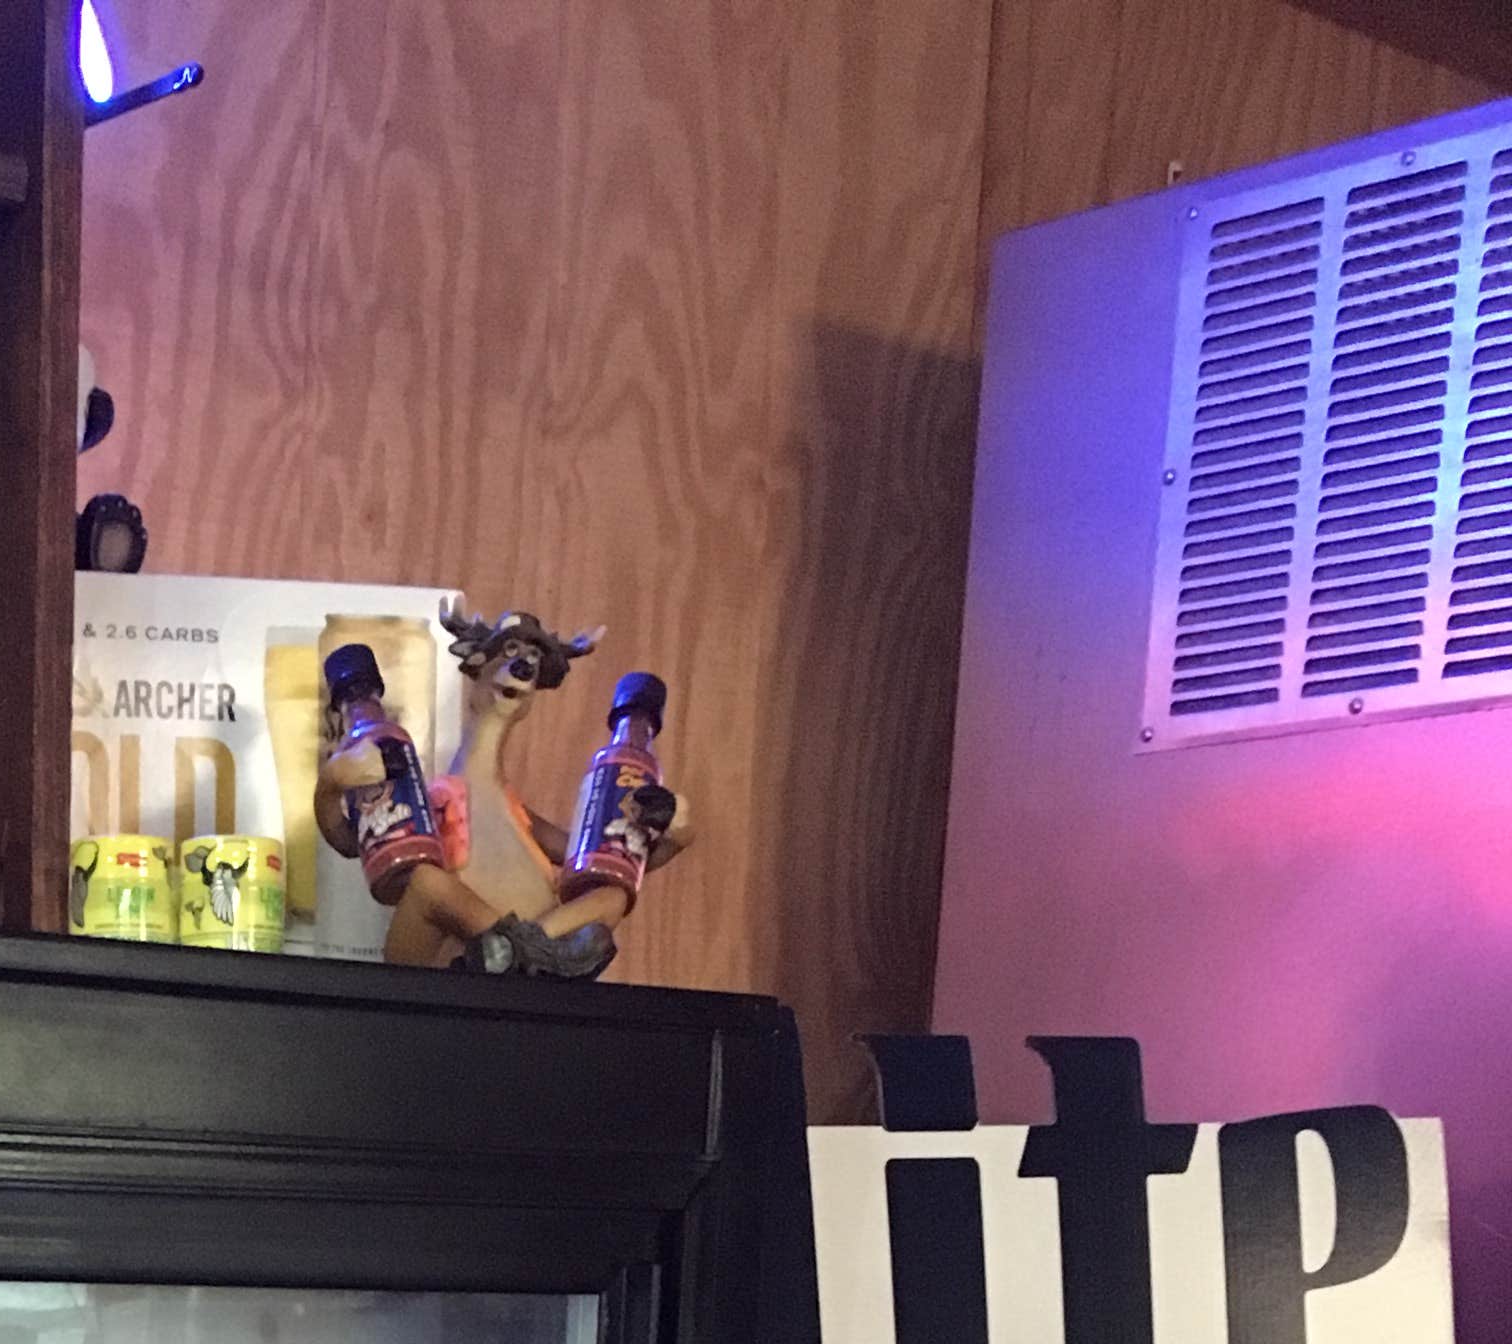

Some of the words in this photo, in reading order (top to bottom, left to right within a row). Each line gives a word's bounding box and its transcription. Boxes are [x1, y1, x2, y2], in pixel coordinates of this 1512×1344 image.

[83, 624, 96, 639] &
[105, 624, 138, 640] 2.6
[145, 626, 219, 643] CARBS
[112, 679, 237, 722] ARCHER
